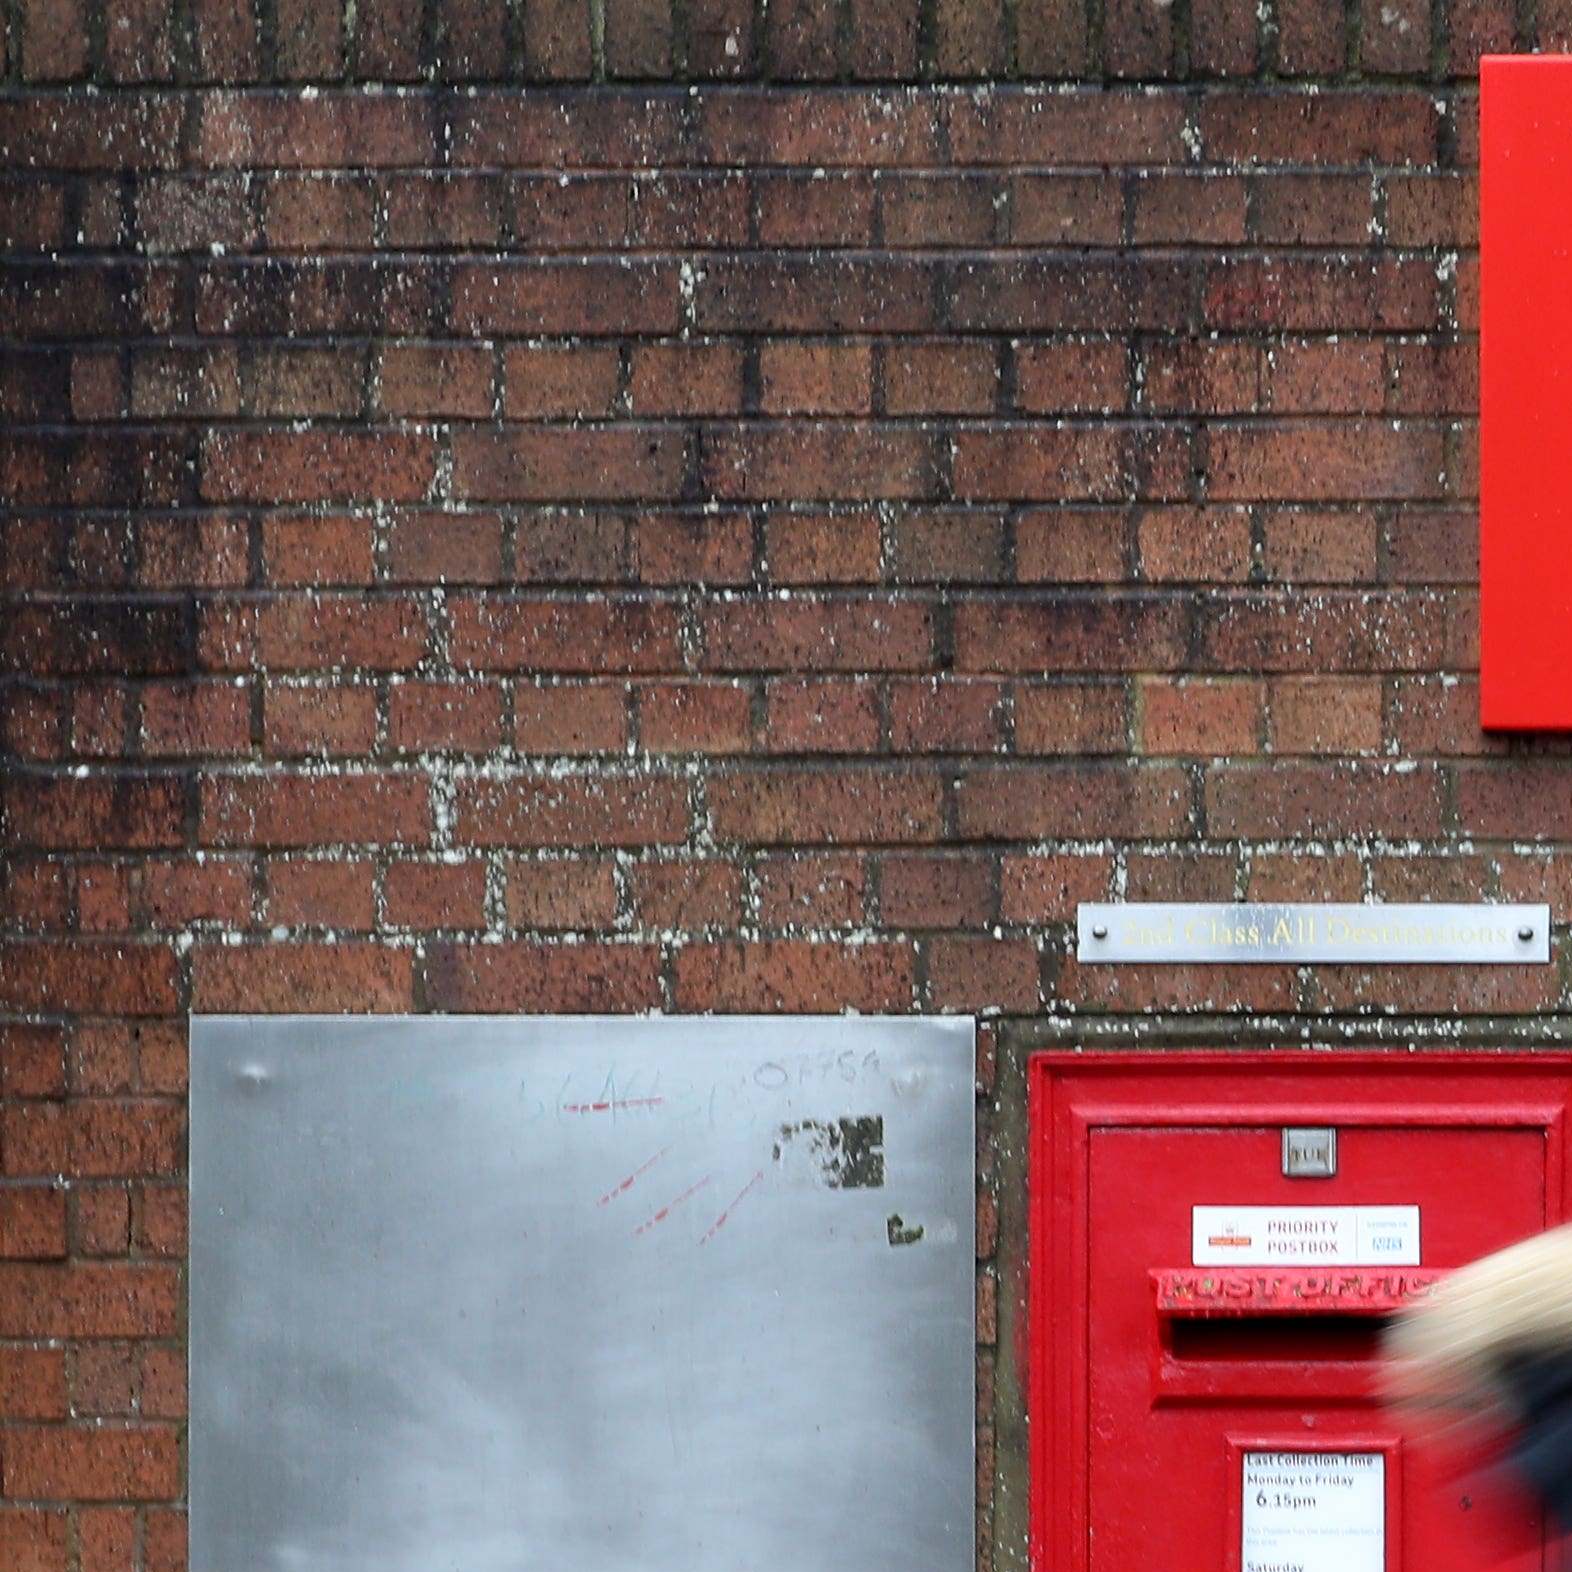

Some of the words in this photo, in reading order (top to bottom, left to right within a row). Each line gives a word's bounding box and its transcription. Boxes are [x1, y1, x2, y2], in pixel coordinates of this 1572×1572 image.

[1122, 918, 1173, 947] 2nd
[1185, 917, 1259, 947] Class
[1271, 916, 1315, 946] All
[1326, 917, 1508, 947] Destinations
[1268, 1220, 1339, 1234] PRIORITY
[1268, 1241, 1339, 1255] POSTBOX
[1166, 1273, 1283, 1298] POST
[1293, 1273, 1438, 1299] OFFIC
[1247, 1454, 1273, 1467] Last
[1278, 1454, 1339, 1467] Collection
[1343, 1454, 1374, 1467] Time
[1247, 1473, 1295, 1487] Monday
[1299, 1475, 1312, 1485] to
[1315, 1474, 1354, 1488] Friday
